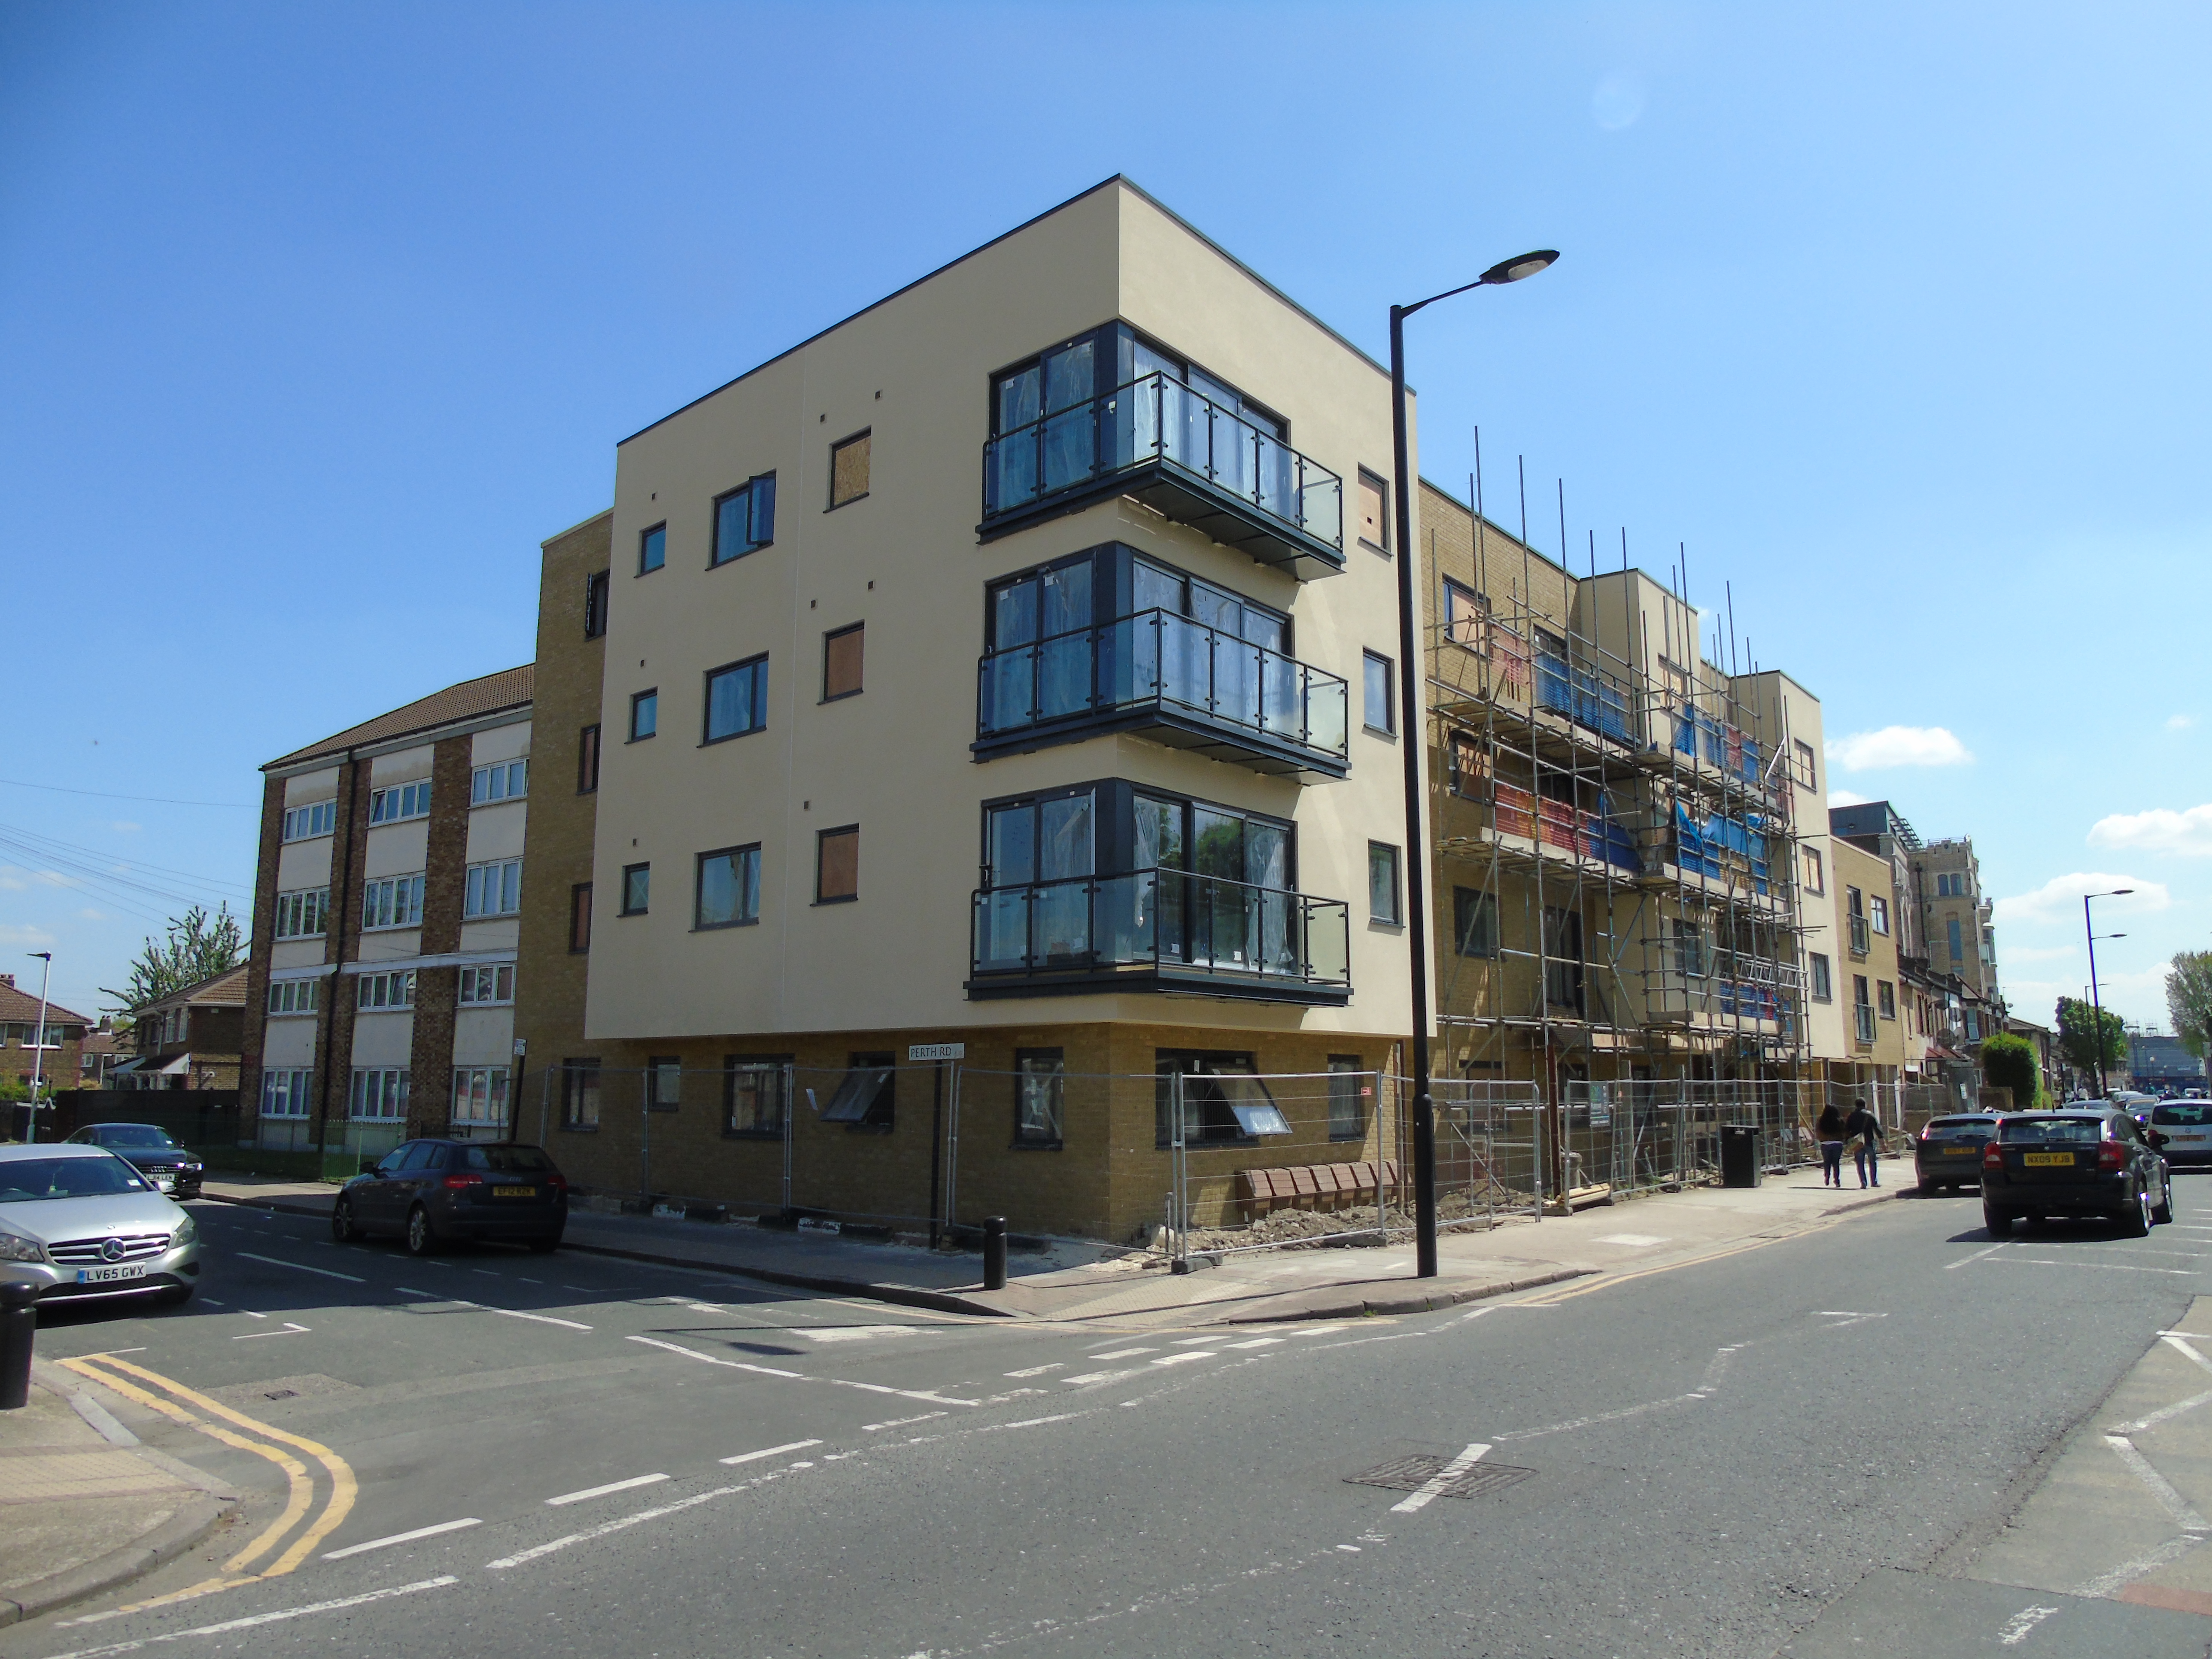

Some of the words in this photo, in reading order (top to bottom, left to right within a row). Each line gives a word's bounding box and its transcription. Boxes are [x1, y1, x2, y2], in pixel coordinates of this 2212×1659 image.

[911, 1047, 936, 1057] PERTH
[940, 1046, 951, 1056] RD
[2028, 1155, 2051, 1163] NX09
[87, 1269, 118, 1281] LV65
[122, 1266, 144, 1277] GWX
